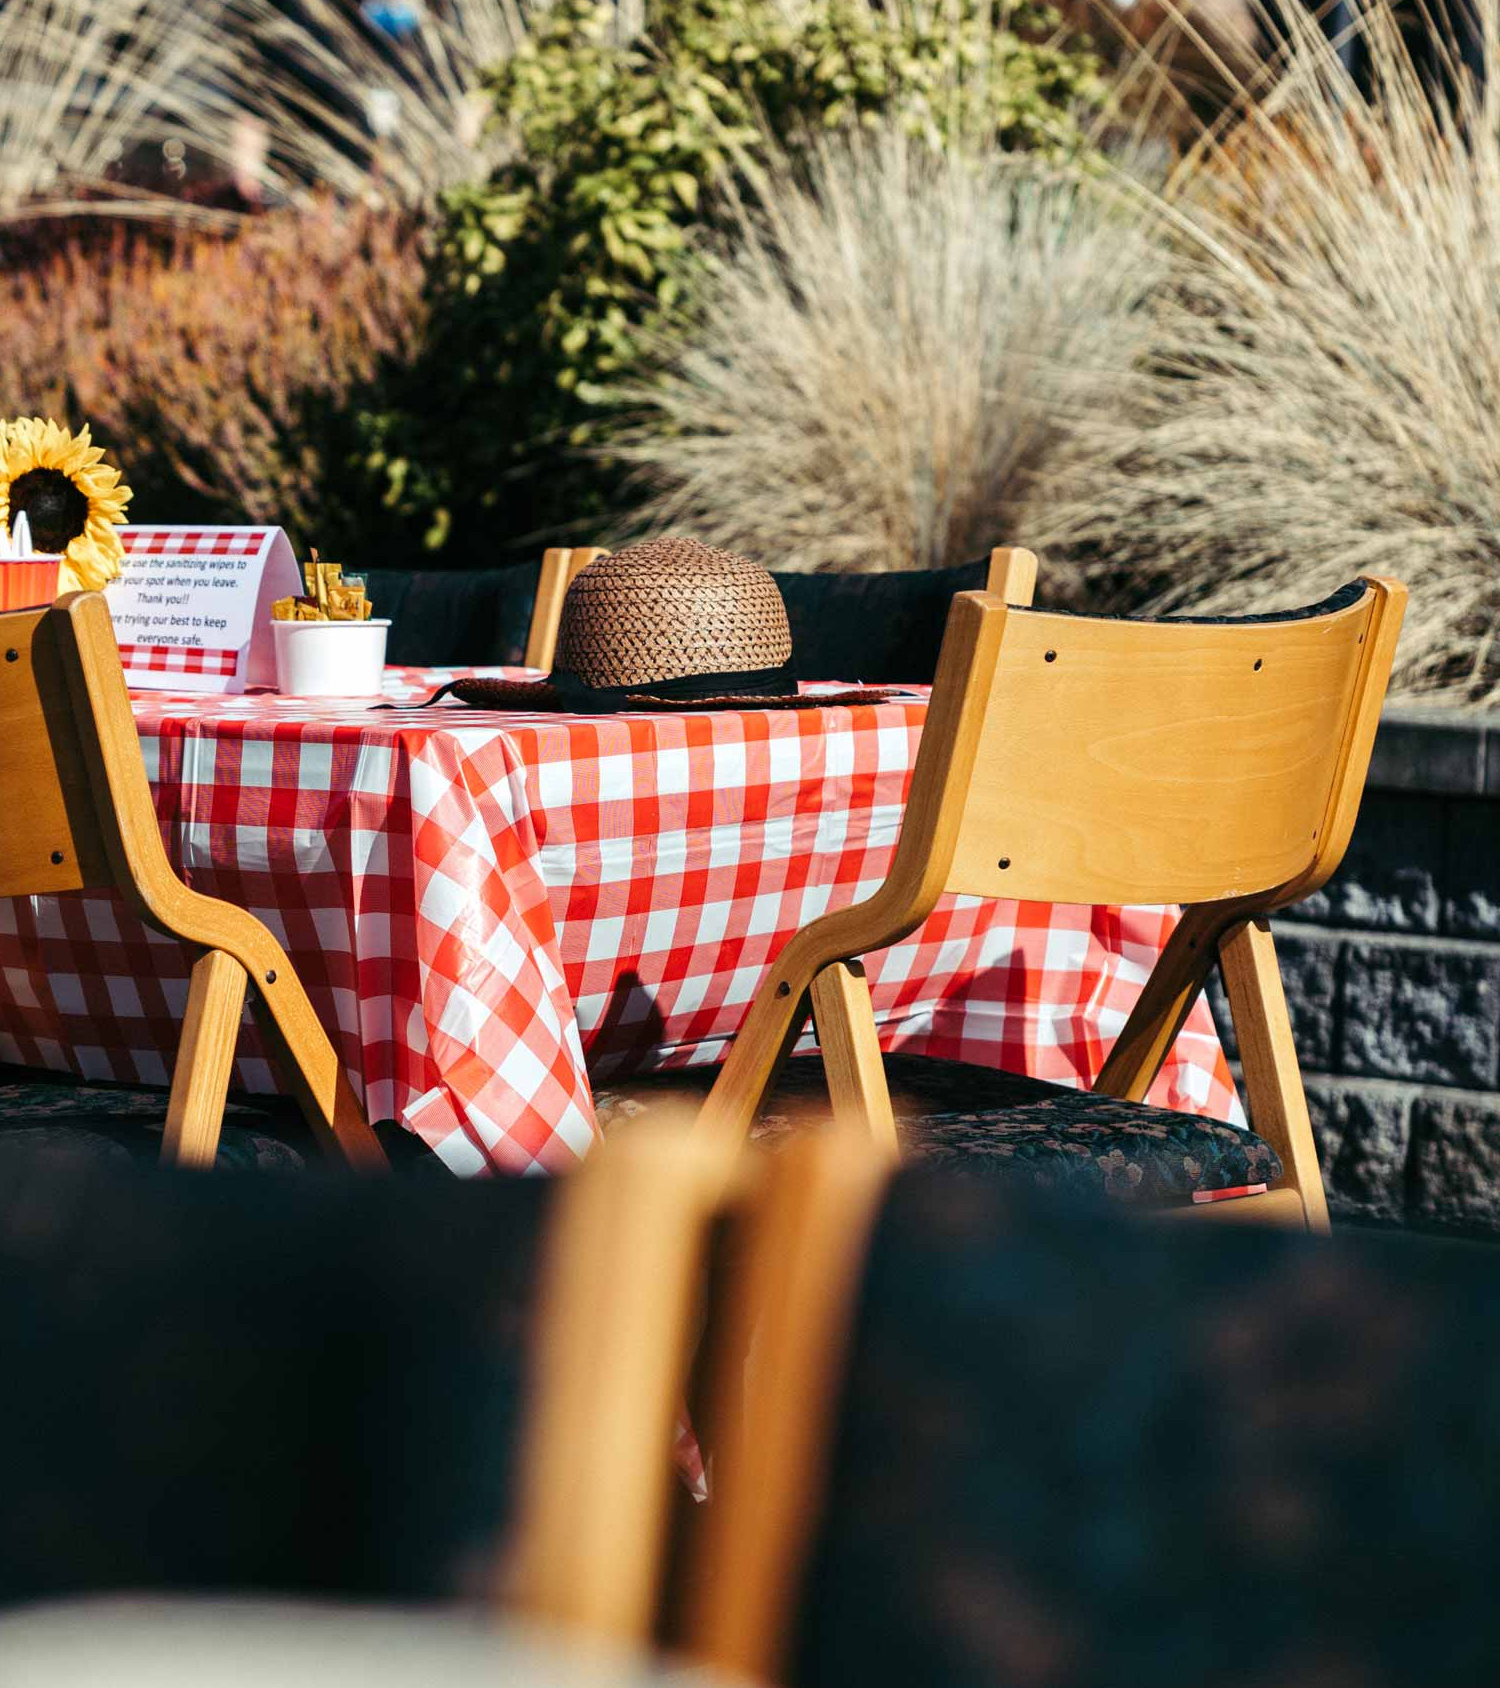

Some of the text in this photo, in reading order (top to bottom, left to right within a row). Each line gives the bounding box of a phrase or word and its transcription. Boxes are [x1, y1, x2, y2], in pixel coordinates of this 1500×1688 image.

[132, 559, 147, 568] use
[149, 558, 164, 568] the
[165, 558, 208, 571] sanitizing
[209, 558, 235, 571] wipes
[237, 560, 248, 569] to
[123, 577, 144, 588] your
[146, 576, 165, 588] spot
[166, 575, 192, 586] when
[193, 578, 210, 589] you
[212, 576, 239, 588] leave.
[137, 592, 190, 606] Thank you!!
[124, 613, 151, 627] trying
[152, 616, 169, 625] our
[170, 614, 190, 626] best
[192, 616, 202, 626] to
[204, 614, 227, 629] keep
[136, 634, 204, 646] everyone safe.
